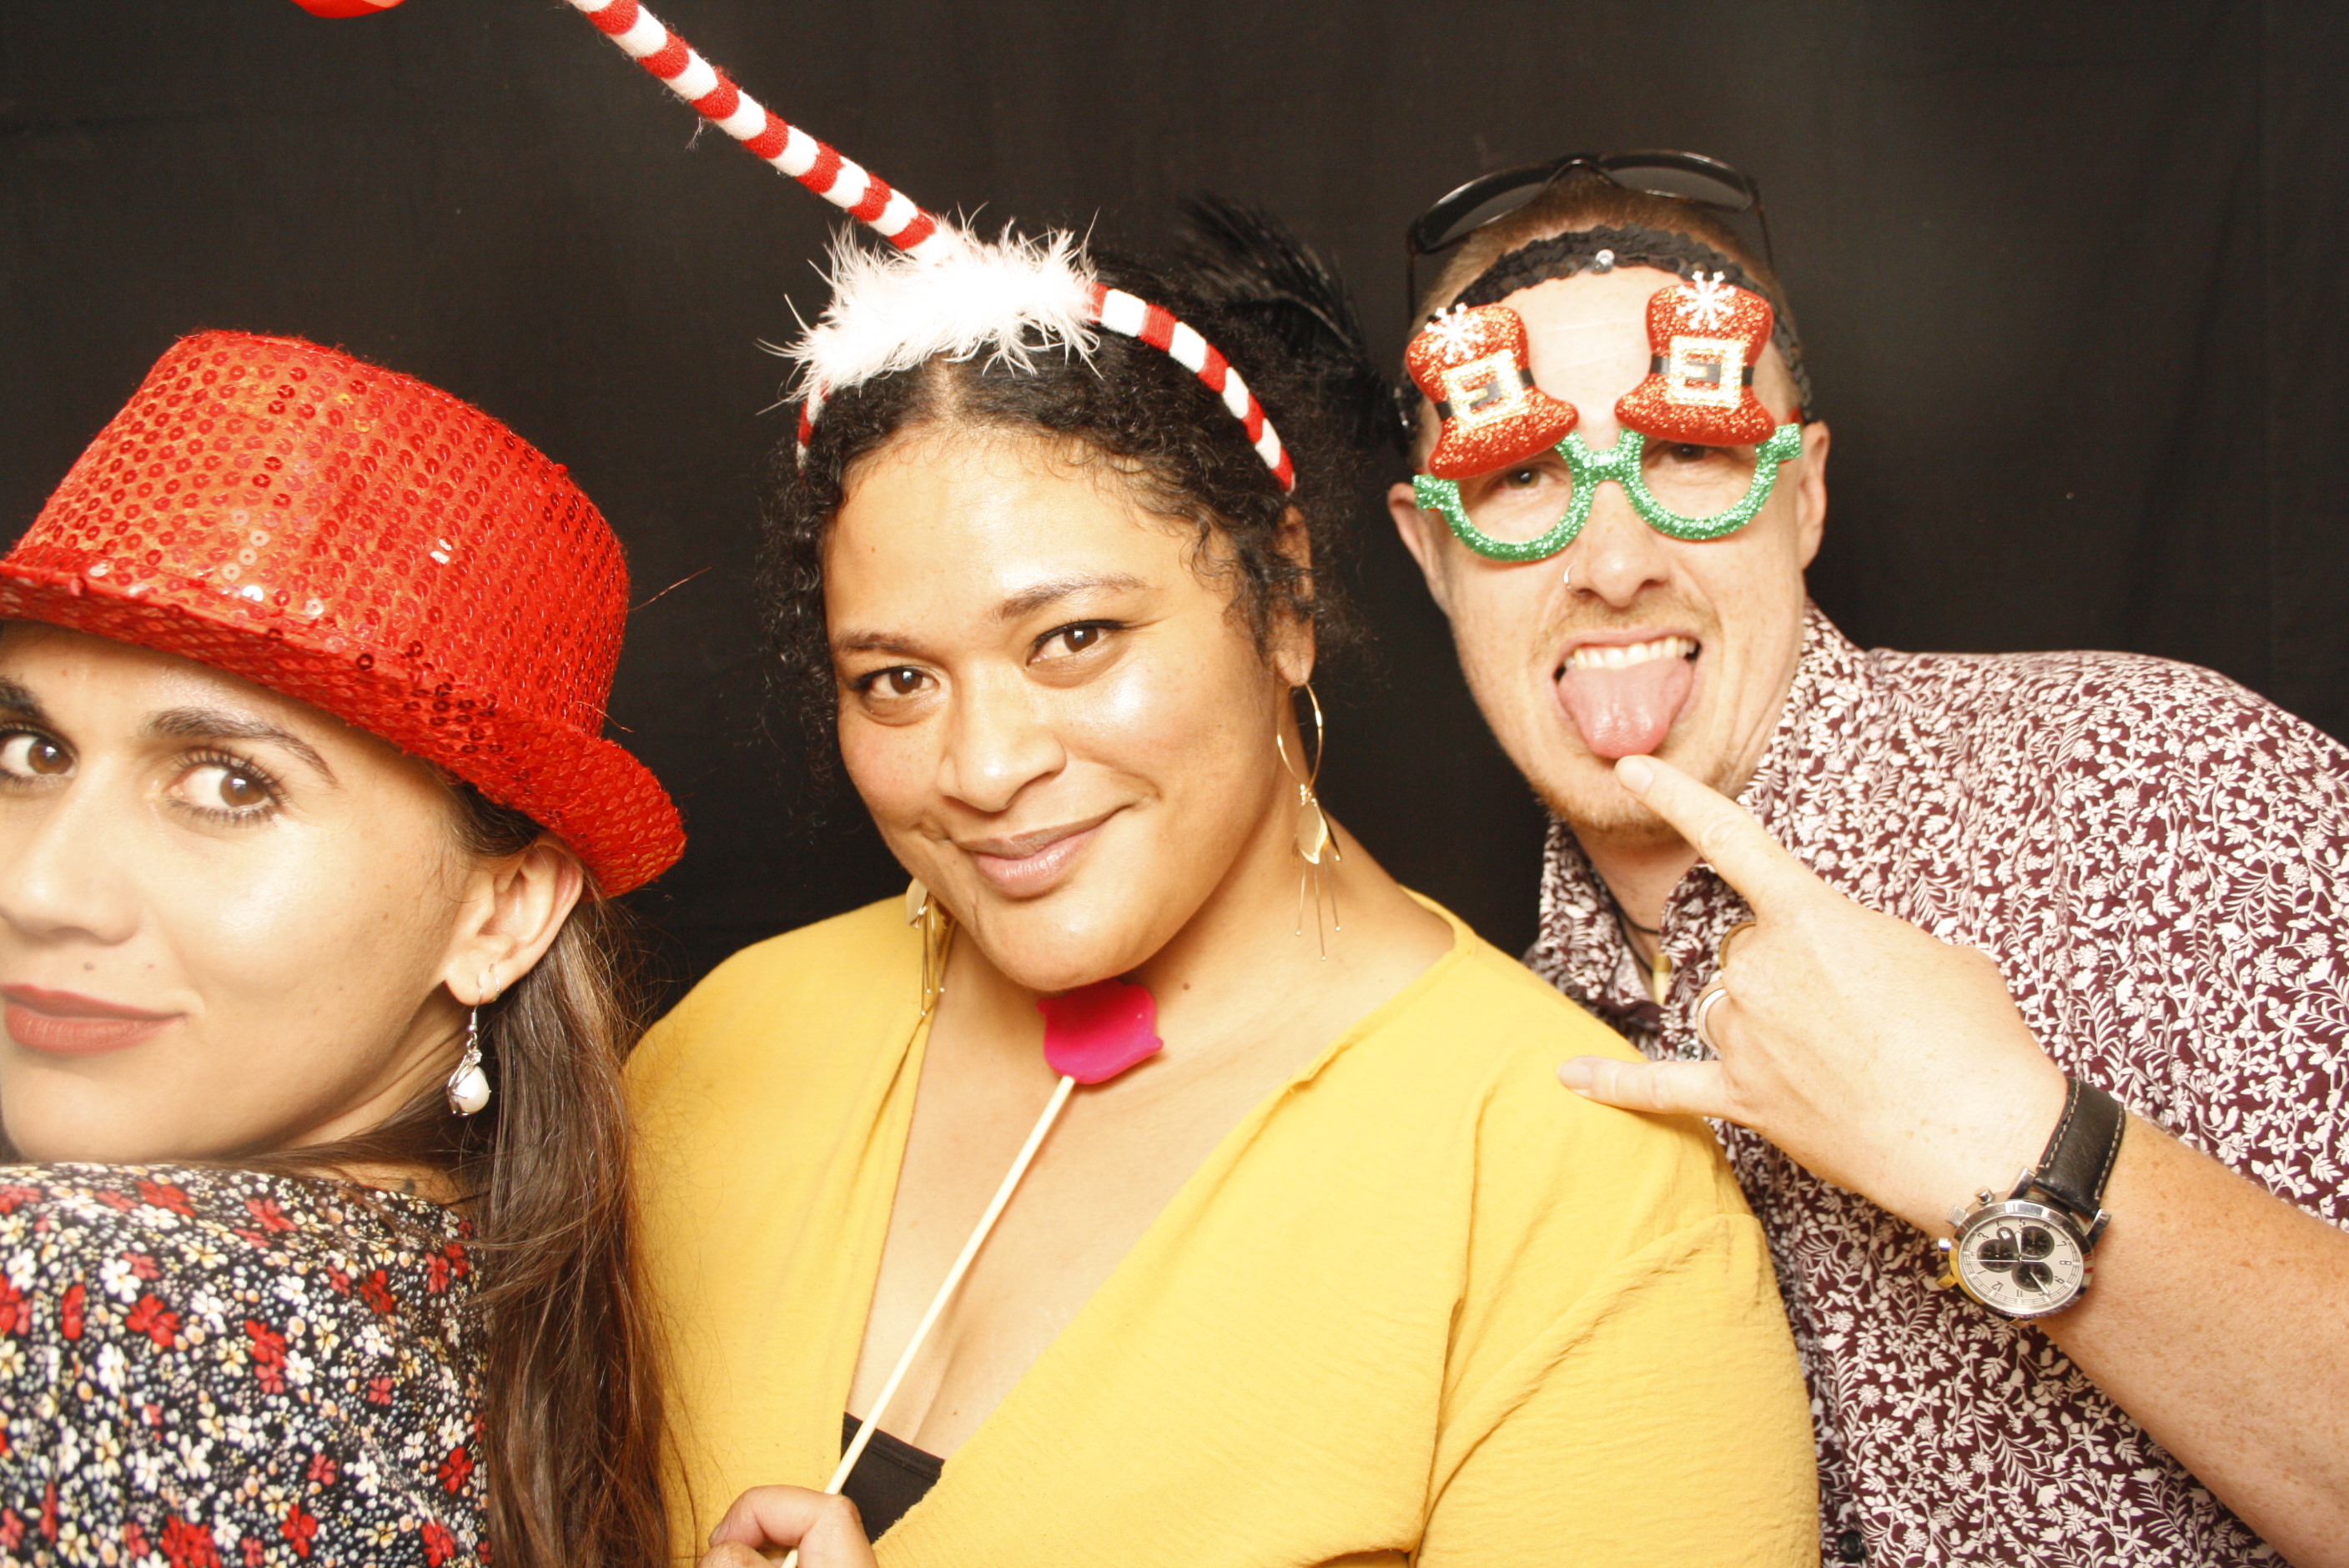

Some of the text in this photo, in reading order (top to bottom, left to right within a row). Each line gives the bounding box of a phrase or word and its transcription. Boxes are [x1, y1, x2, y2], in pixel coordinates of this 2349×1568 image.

[1977, 1232, 1989, 1240] 3
[2055, 1275, 2065, 1284] 9
[1991, 1280, 2004, 1291] 12
